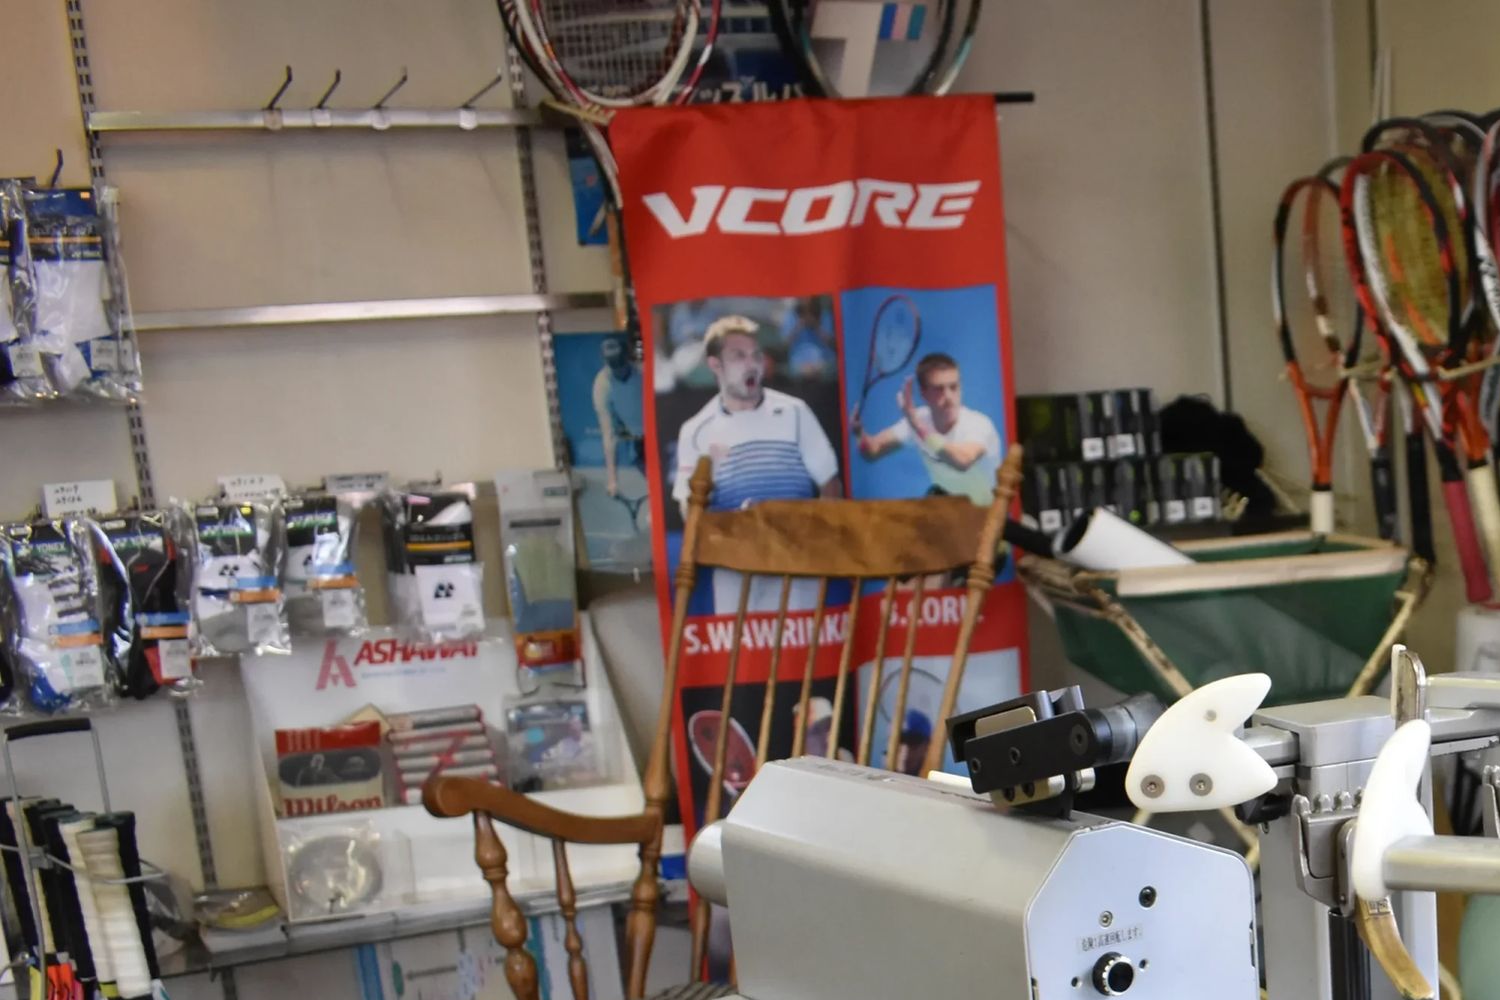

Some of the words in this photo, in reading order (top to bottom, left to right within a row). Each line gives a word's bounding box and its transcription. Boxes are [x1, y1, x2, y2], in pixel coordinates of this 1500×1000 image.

[642, 179, 981, 238] VCORE
[36, 541, 67, 553] YONEX
[284, 793, 383, 817] Wilson
